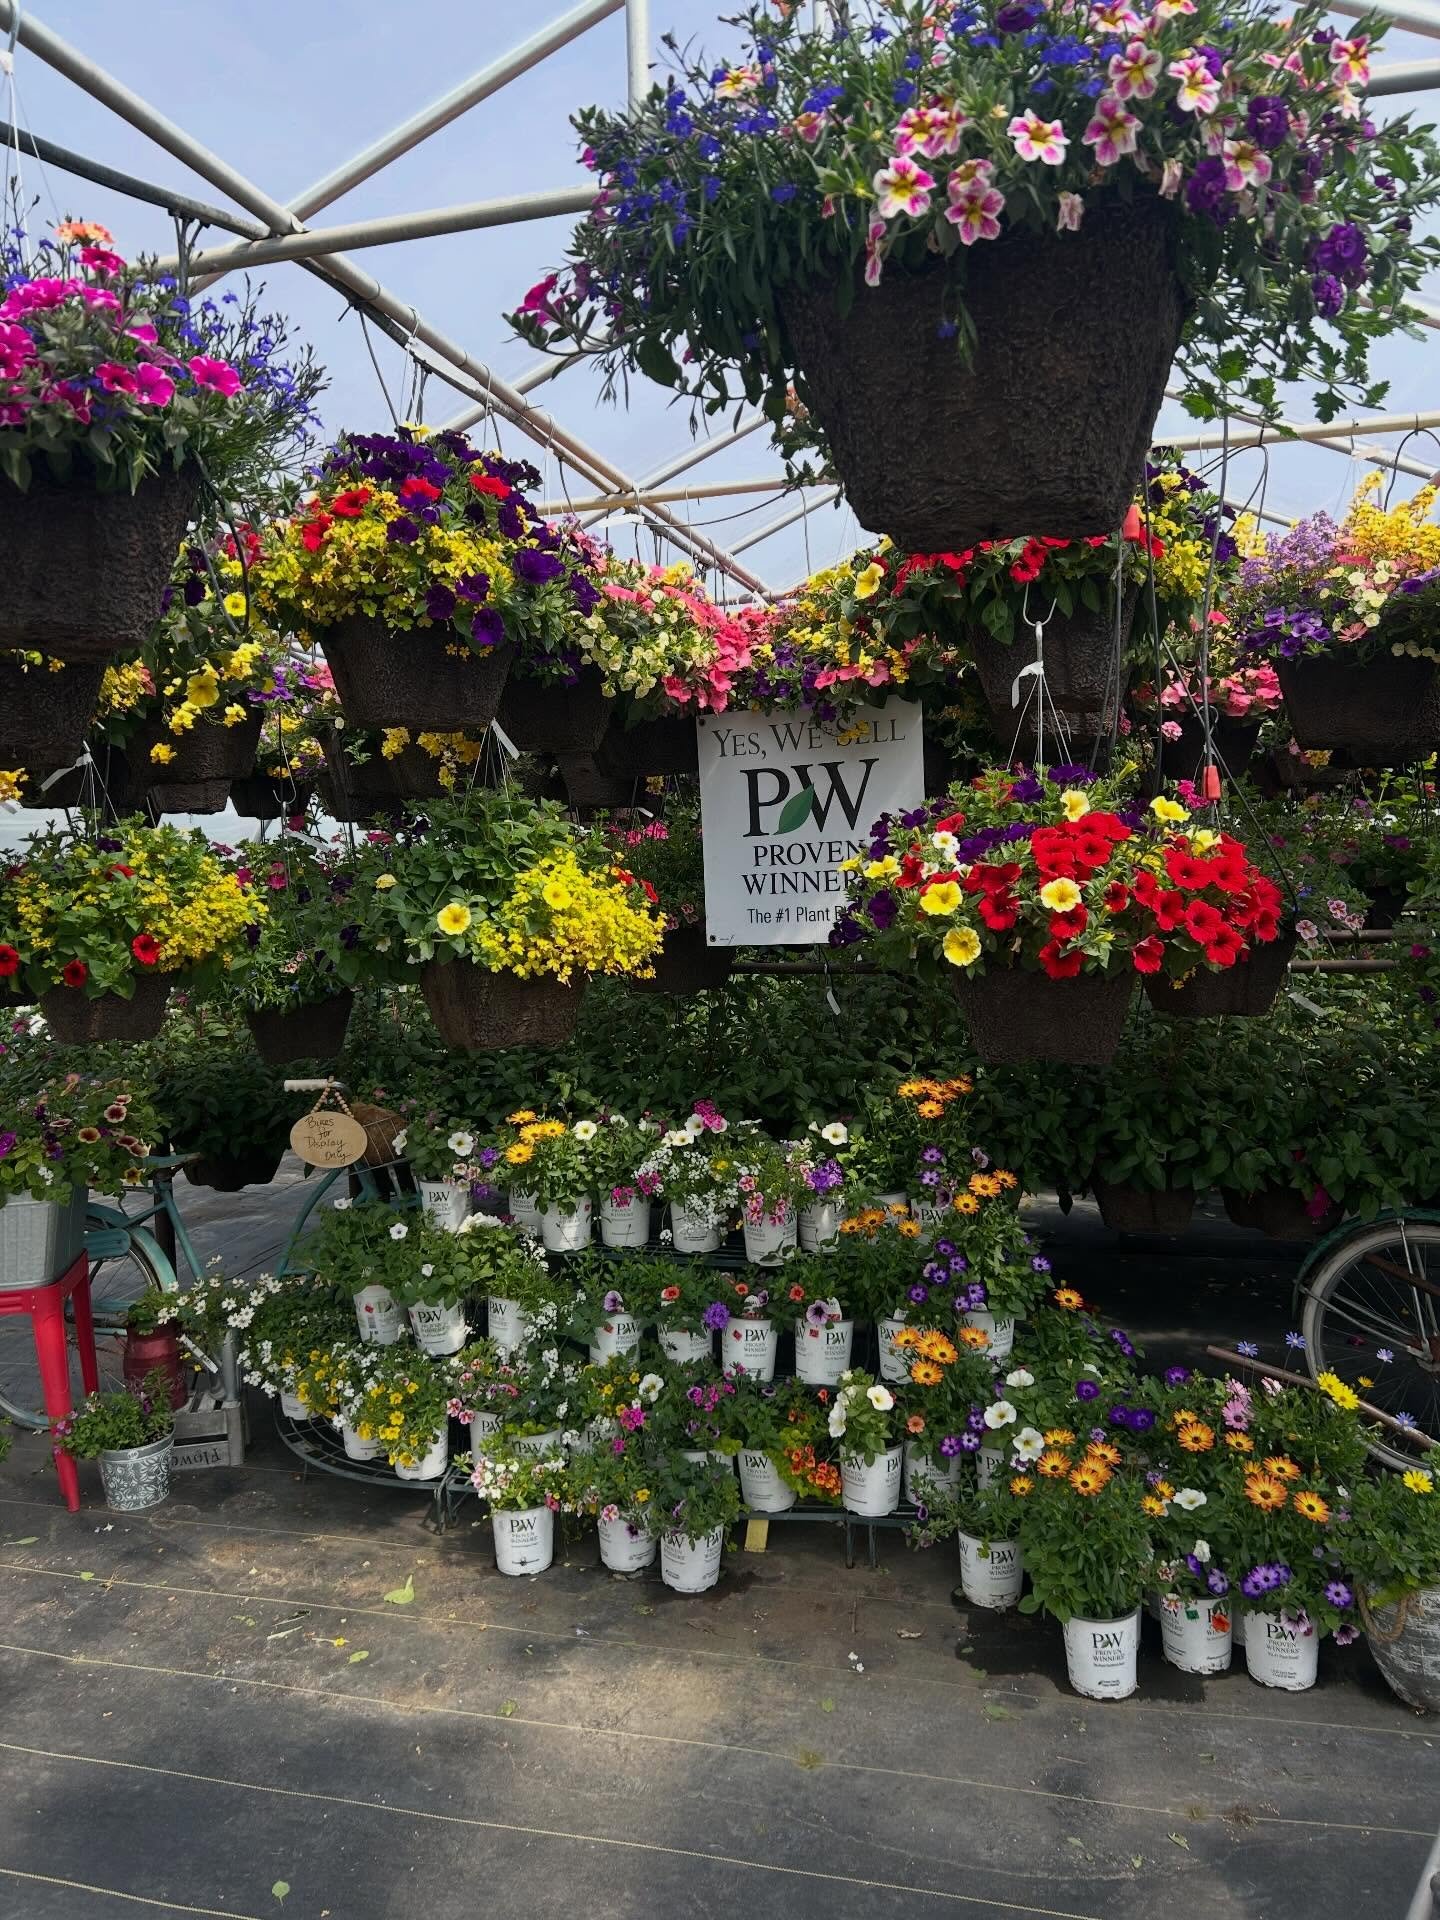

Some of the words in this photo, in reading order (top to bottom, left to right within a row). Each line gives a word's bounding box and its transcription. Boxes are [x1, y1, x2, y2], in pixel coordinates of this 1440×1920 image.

[712, 729, 766, 759] YES,
[768, 721, 823, 752] WE
[740, 758, 879, 837] PW
[753, 840, 865, 868] PROVEN
[741, 868, 860, 896] WINNER
[747, 908, 772, 924] The
[776, 907, 791, 923] #1
[796, 906, 830, 922] Plant
[921, 1208, 945, 1224] PW
[417, 1309, 442, 1323] PW
[616, 1320, 639, 1335] PW
[744, 1328, 769, 1342] PW
[825, 1331, 848, 1345] PW
[744, 1454, 768, 1469] PW
[510, 1516, 537, 1532] PW
[990, 1547, 1017, 1564] PW
[1091, 1631, 1124, 1649] PW
